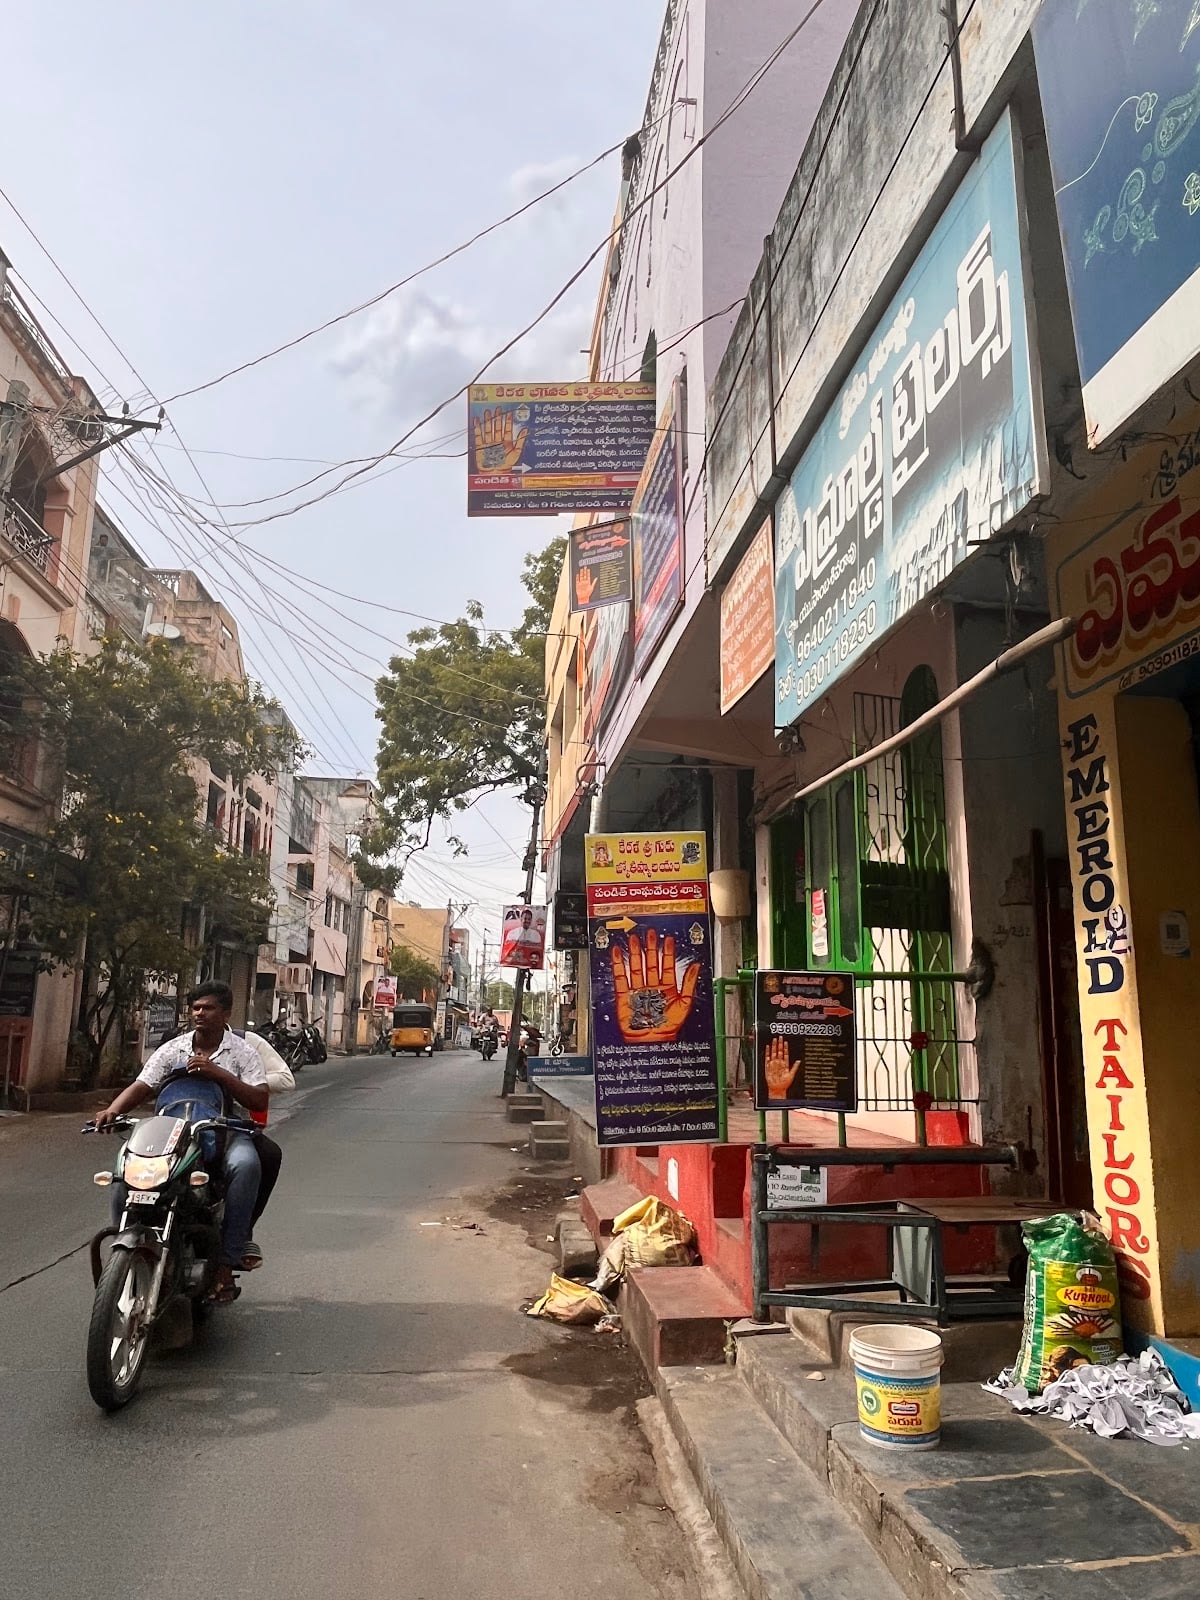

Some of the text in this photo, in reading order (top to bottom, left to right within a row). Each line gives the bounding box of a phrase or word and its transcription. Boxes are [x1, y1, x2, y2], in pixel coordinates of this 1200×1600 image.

[574, 386, 655, 400] జ్యోతిష్యాలయ
[796, 557, 877, 668] 9640211840
[796, 600, 877, 705] 9030118250
[1138, 636, 1200, 680] 90301182
[618, 838, 676, 857] కేరళ శ్రీ గురు
[1067, 713, 1126, 994] EMEROLD
